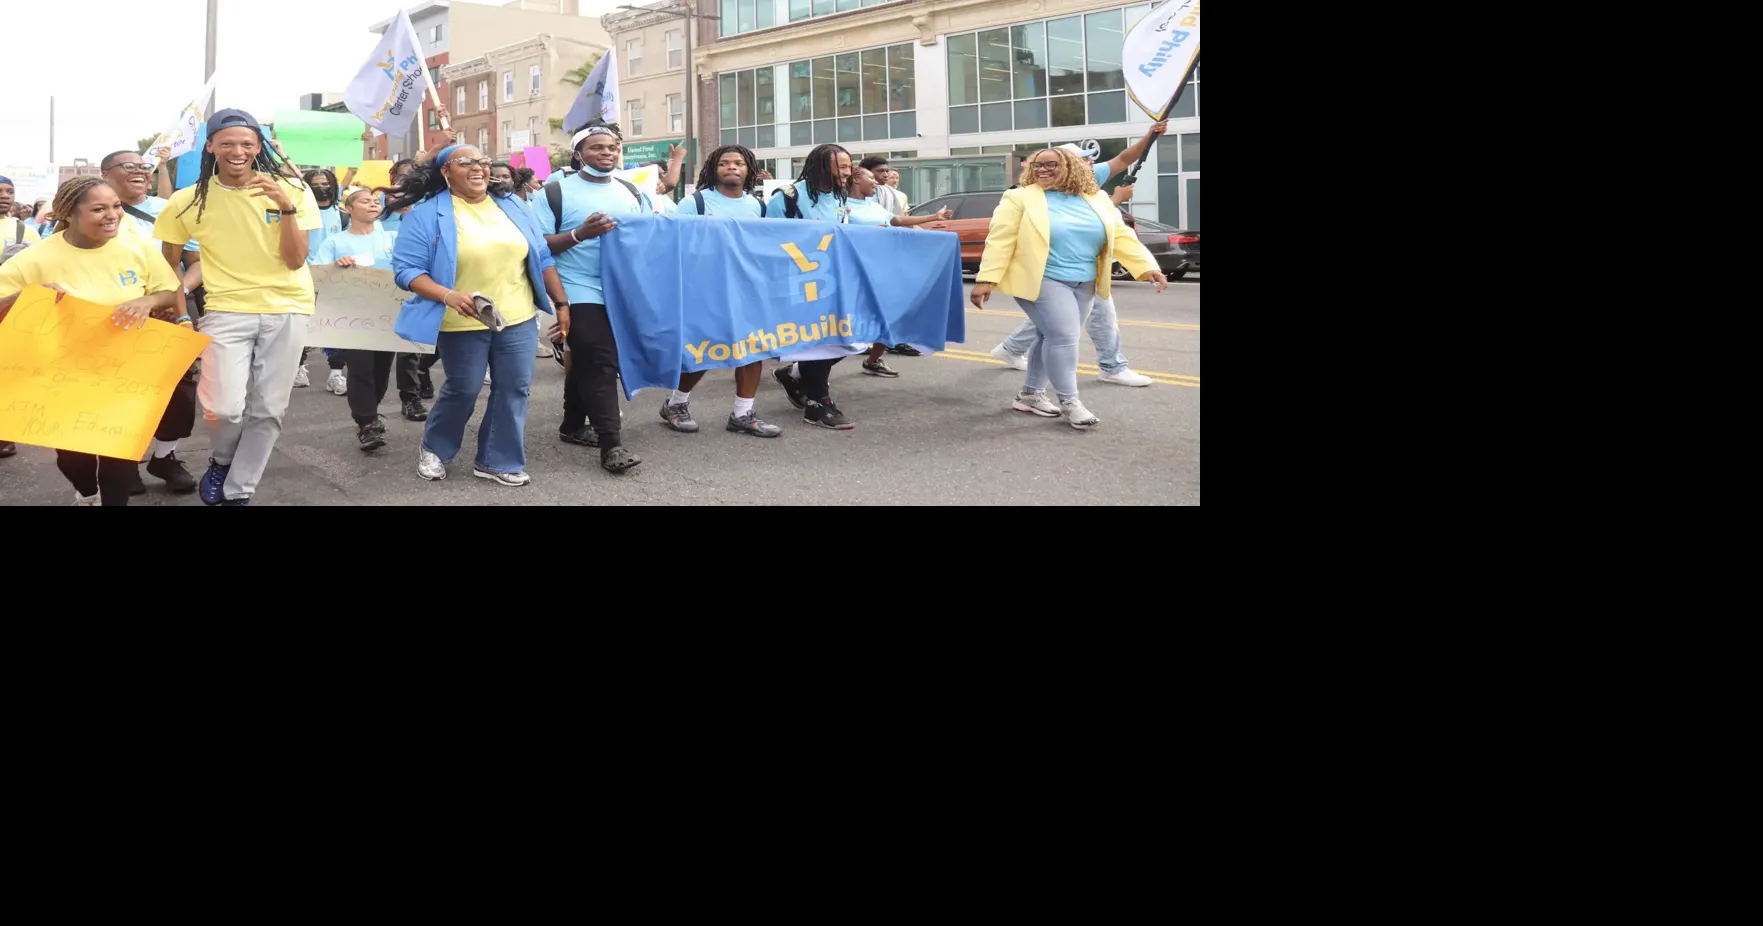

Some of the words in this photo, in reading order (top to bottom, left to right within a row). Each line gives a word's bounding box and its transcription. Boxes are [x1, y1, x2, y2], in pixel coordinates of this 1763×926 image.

[1139, 29, 1190, 77] Philly
[133, 328, 189, 354] OF
[685, 313, 853, 364] YouthBuild
[50, 345, 127, 377] 2024
